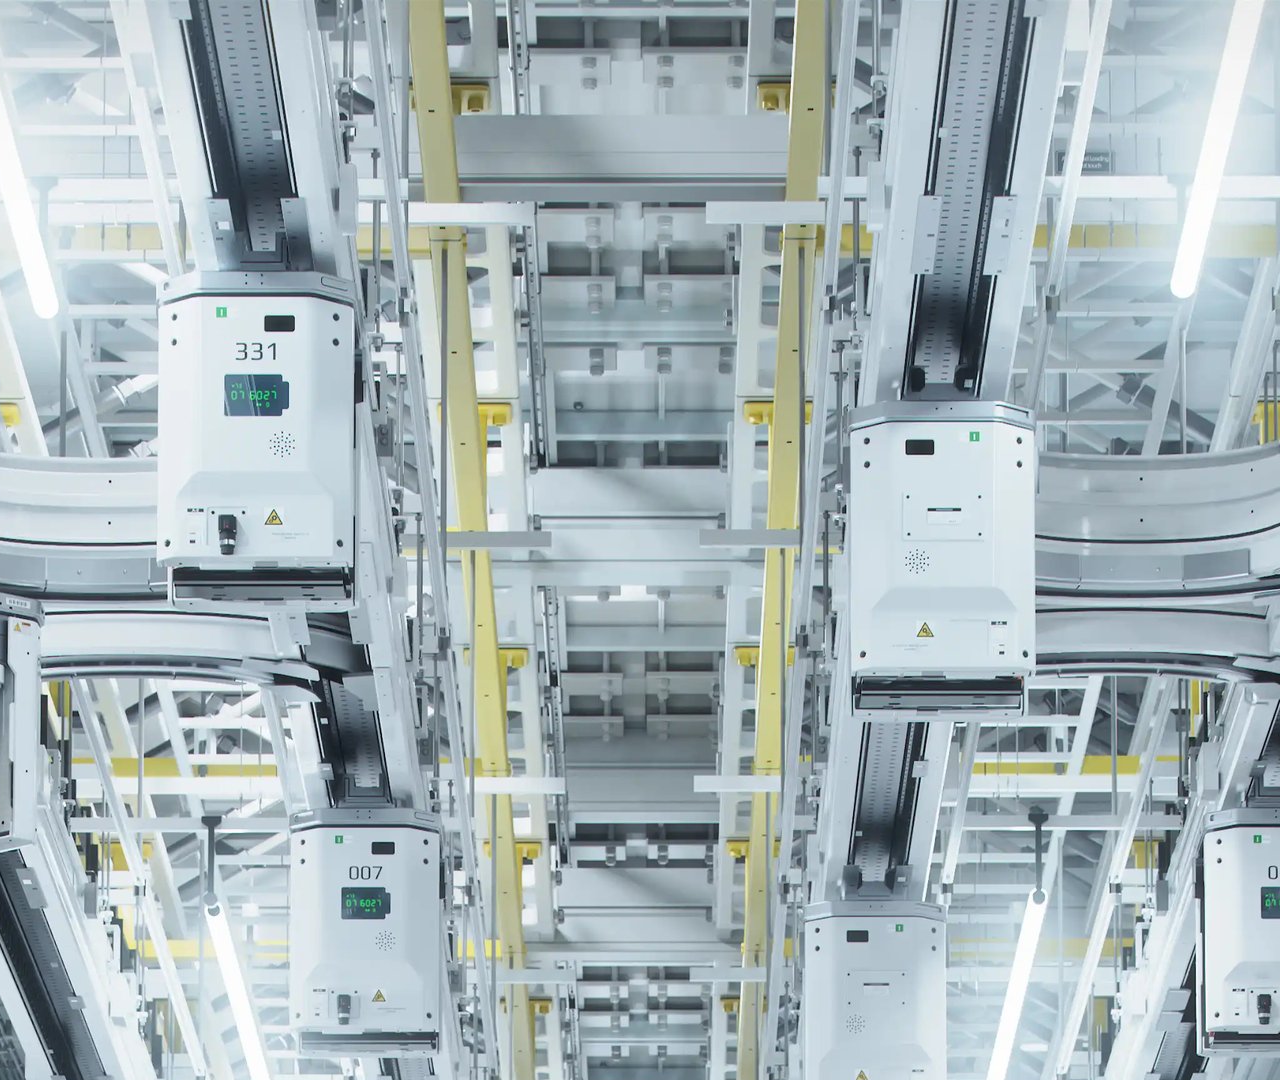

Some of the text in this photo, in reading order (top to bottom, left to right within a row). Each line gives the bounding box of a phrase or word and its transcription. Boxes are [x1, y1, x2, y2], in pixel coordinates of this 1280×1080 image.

[235, 342, 277, 361] 331
[231, 390, 277, 401] 07 6027
[349, 865, 383, 880] 007
